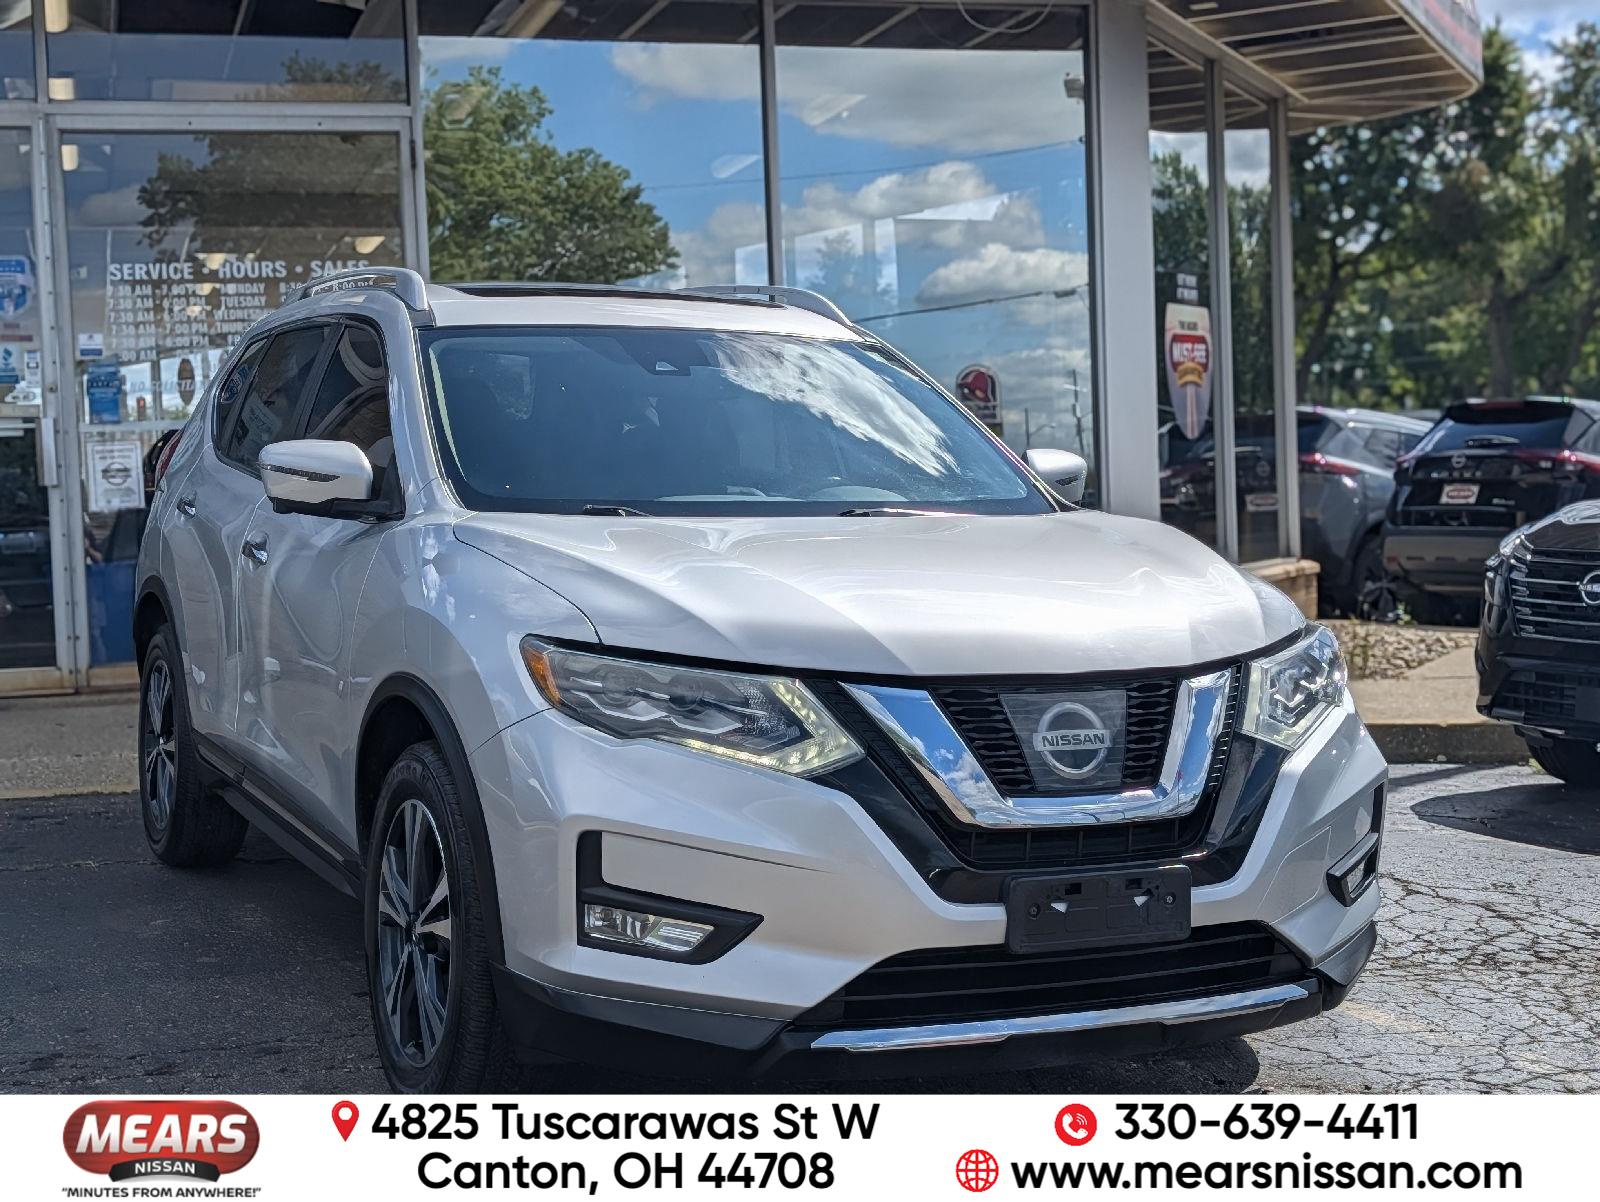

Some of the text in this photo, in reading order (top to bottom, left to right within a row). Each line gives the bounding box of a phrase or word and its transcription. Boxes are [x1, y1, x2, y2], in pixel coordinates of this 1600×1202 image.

[109, 262, 194, 280] SERVICE
[218, 261, 288, 279] HOURS
[134, 284, 152, 295] AM
[135, 297, 154, 309] AM
[219, 295, 267, 308] TUESDAY
[192, 335, 210, 347] PM
[1042, 732, 1105, 748] NISSAN
